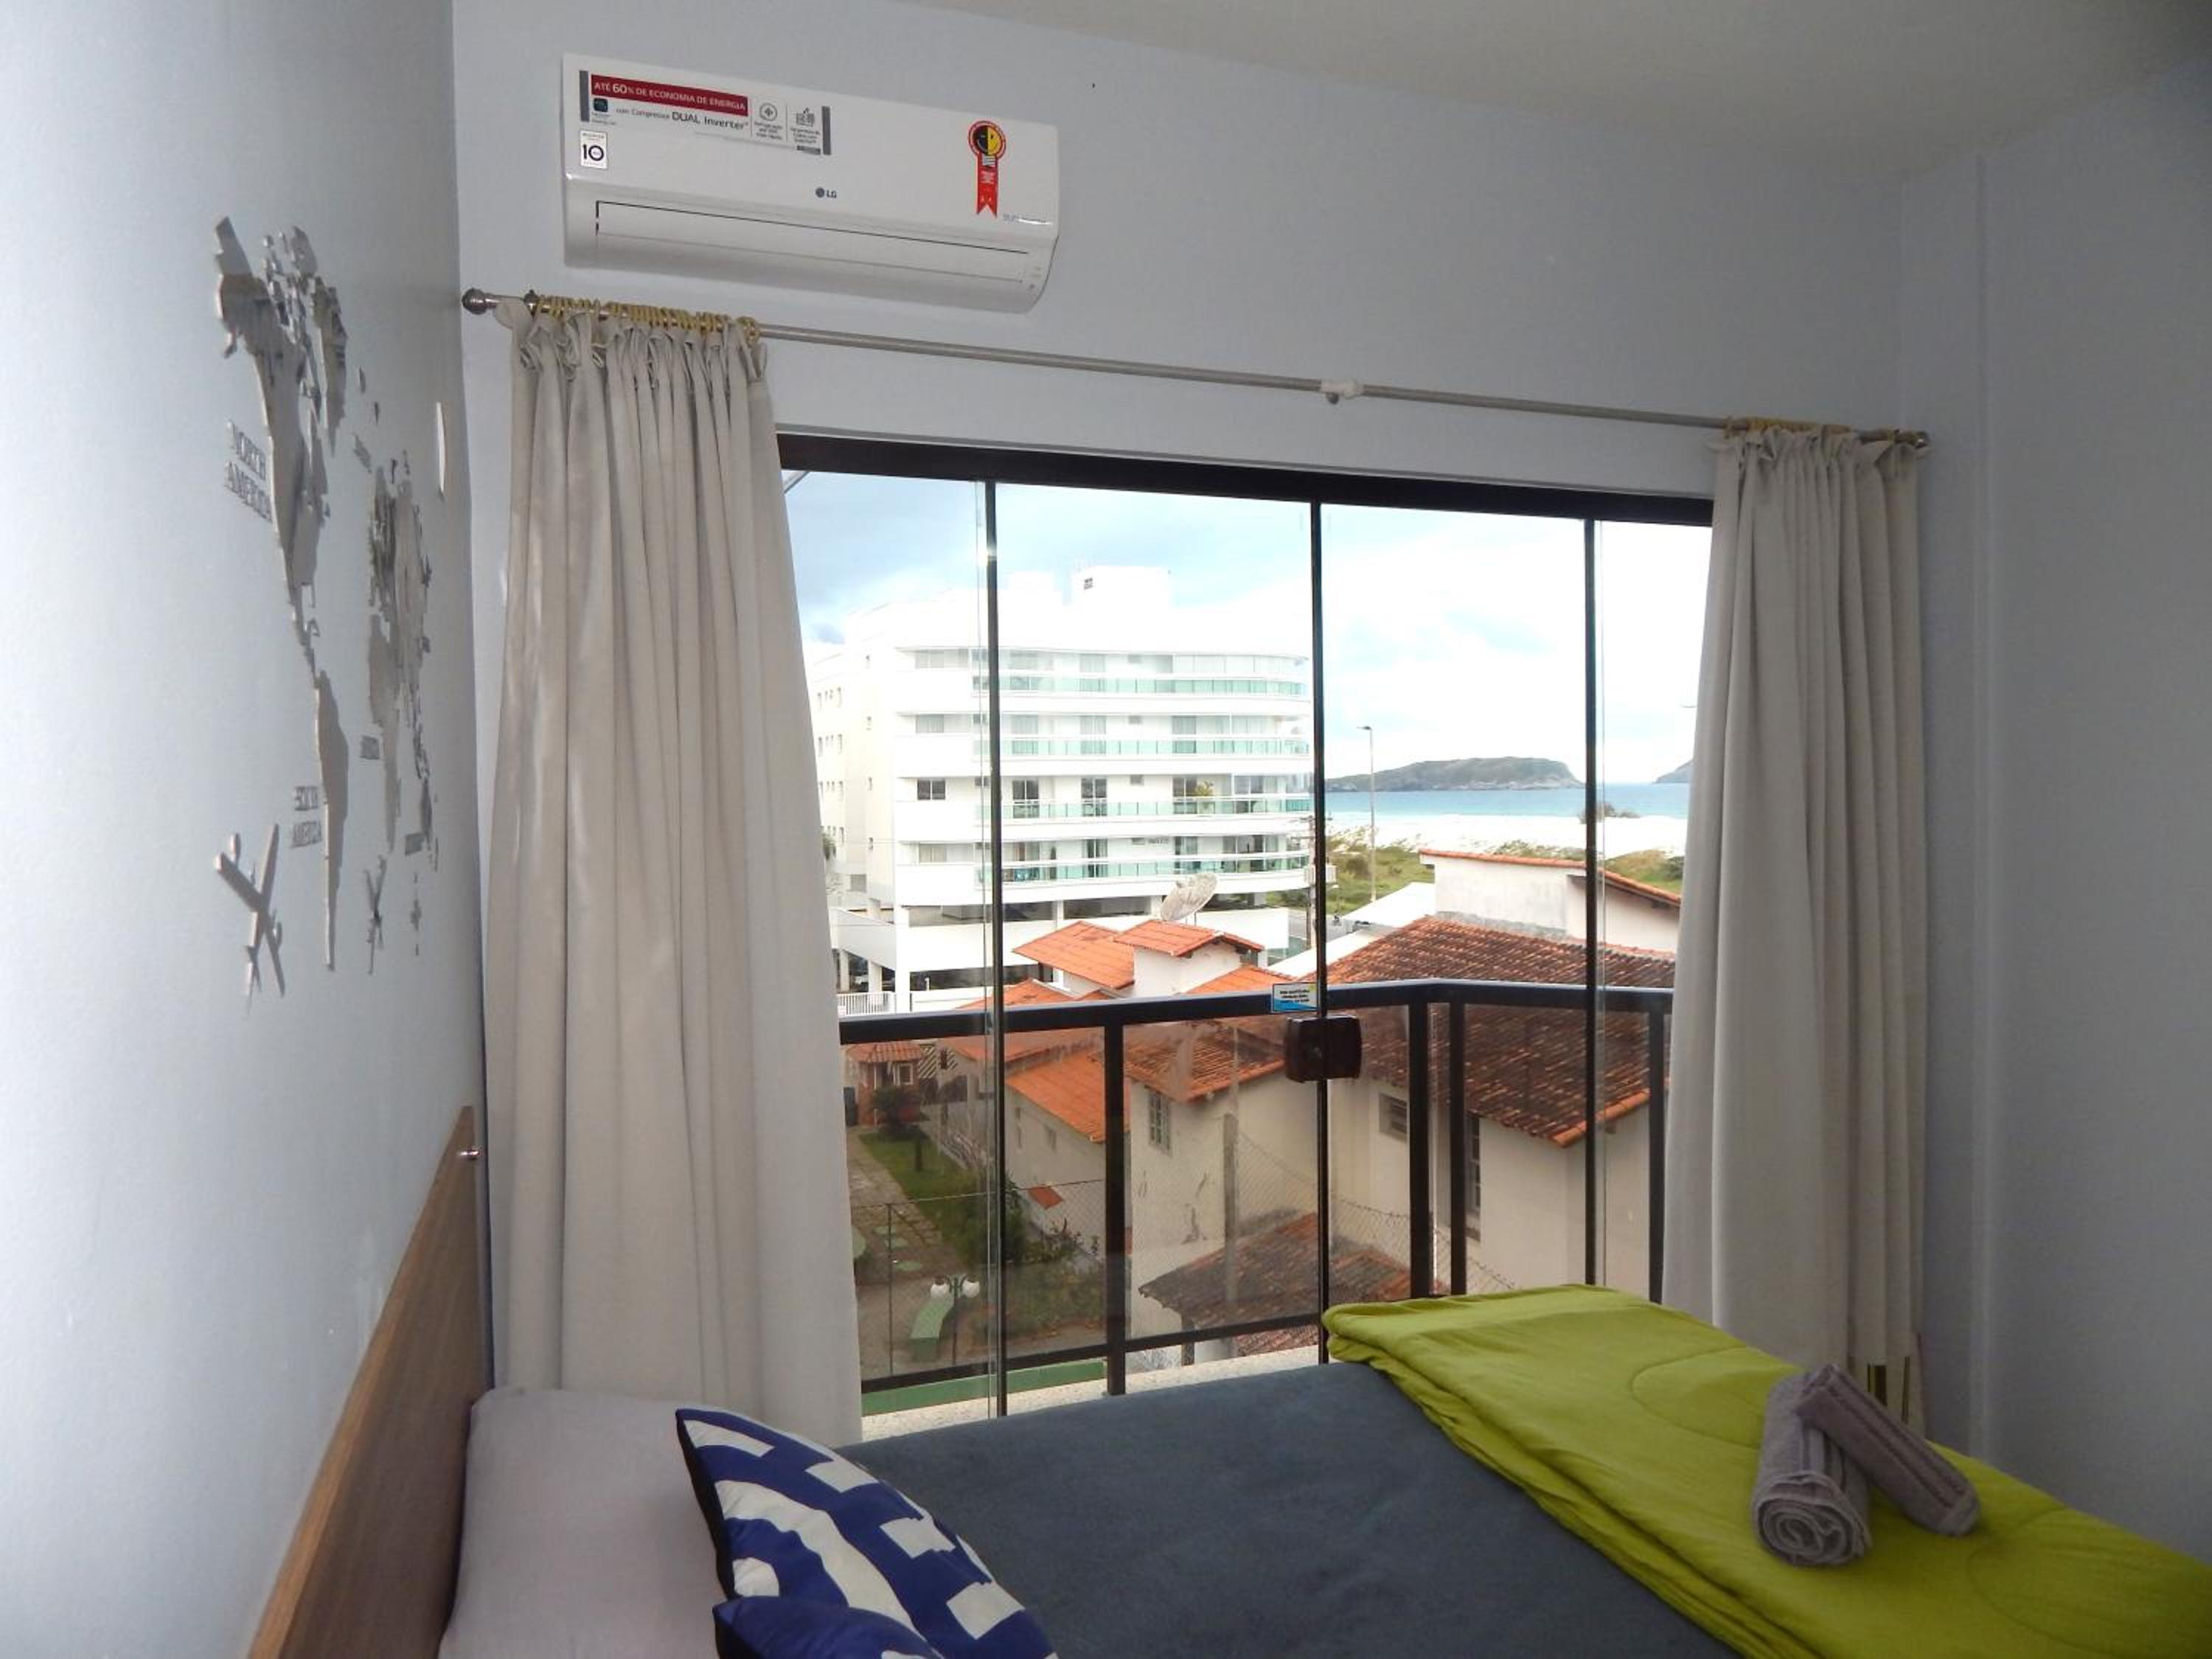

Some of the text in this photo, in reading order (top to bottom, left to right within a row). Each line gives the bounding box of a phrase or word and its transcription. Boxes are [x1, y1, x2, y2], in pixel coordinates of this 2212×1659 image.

[594, 81, 745, 110] ATÉ 60% DE ECONOMIA DE ENERGIA
[672, 112, 700, 125] DUAL
[582, 144, 604, 161] 10
